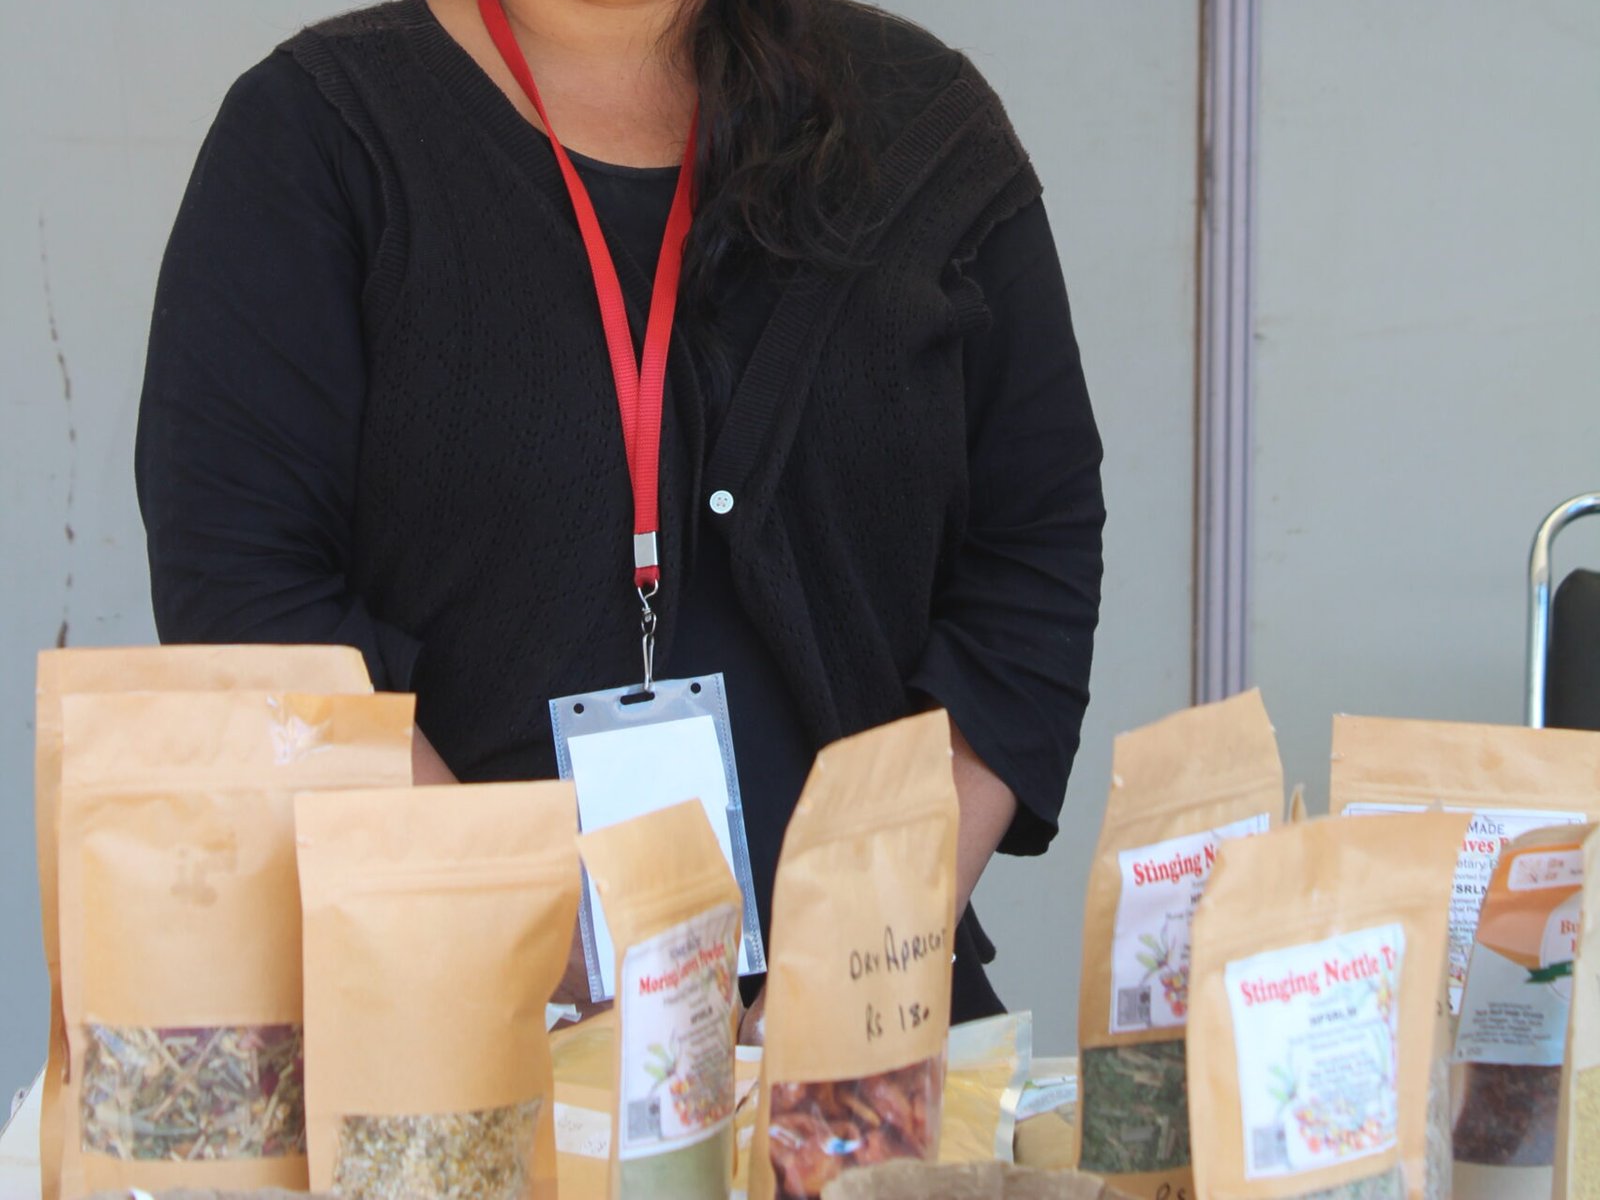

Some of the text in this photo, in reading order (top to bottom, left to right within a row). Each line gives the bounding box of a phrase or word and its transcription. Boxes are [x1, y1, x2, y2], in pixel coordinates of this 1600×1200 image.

[1132, 852, 1202, 887] Stinging
[1240, 969, 1320, 1006] Stinging
[1323, 953, 1380, 987] Nettle
